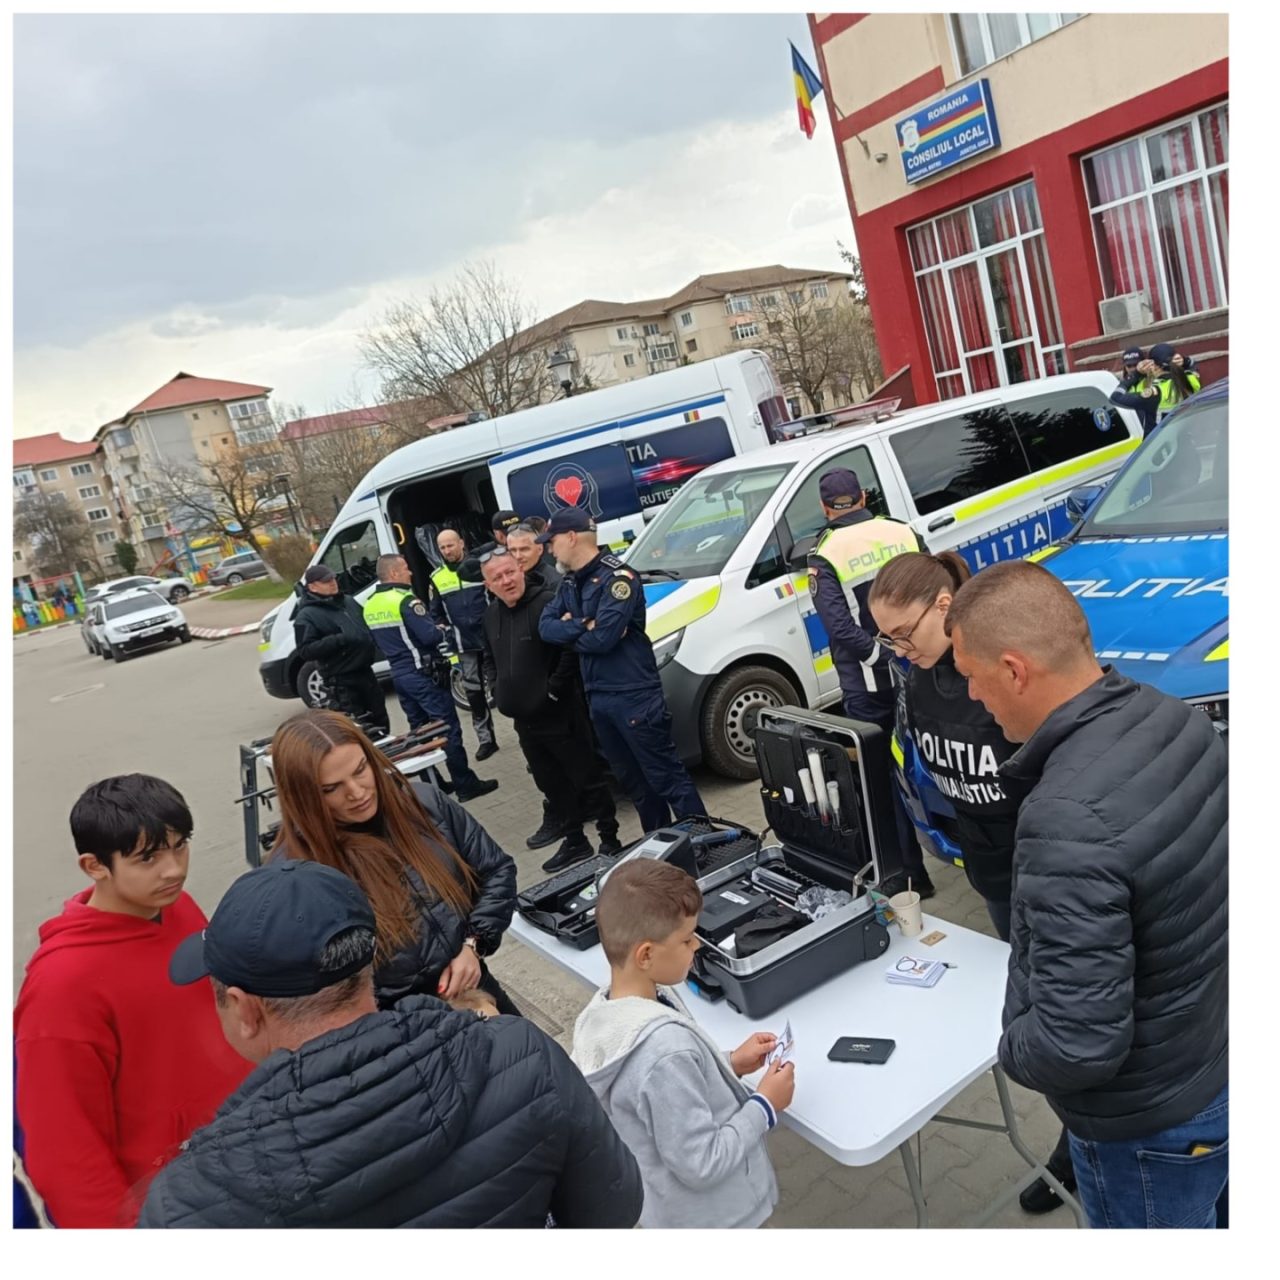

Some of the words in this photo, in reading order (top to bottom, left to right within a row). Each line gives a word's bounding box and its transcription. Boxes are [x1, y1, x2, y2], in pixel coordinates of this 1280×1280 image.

[927, 94, 968, 121] ROMANIA
[907, 140, 953, 169] CONSILIUL
[953, 124, 985, 147] LOCAL
[848, 543, 908, 572] POLITIA
